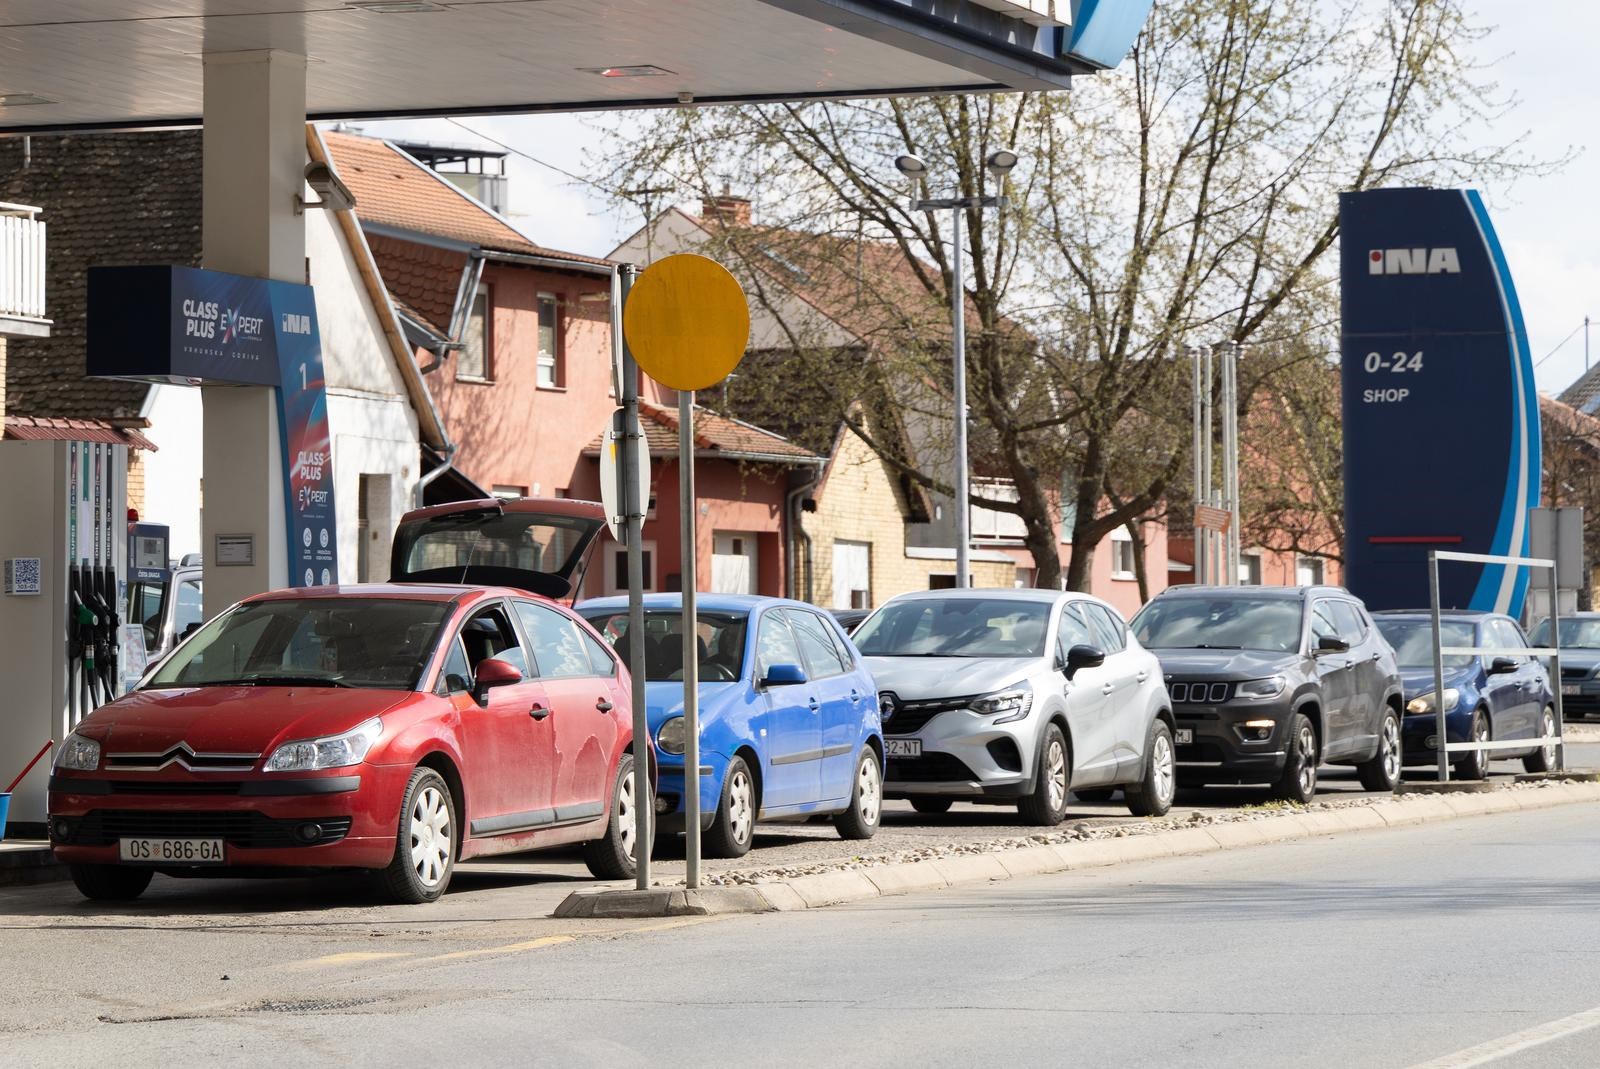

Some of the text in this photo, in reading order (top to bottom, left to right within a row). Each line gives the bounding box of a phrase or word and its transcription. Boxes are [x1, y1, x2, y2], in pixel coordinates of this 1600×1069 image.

[1369, 248, 1461, 275] INA
[183, 299, 219, 321] CLASS
[186, 319, 216, 339] PLUS
[282, 313, 311, 335] INA
[1364, 351, 1423, 373] 0-24
[299, 362, 307, 391] 1
[1363, 388, 1410, 403] SHOP
[298, 451, 325, 467] CLASS
[300, 466, 322, 481] PLUS
[130, 840, 222, 859] OS 686-GA
